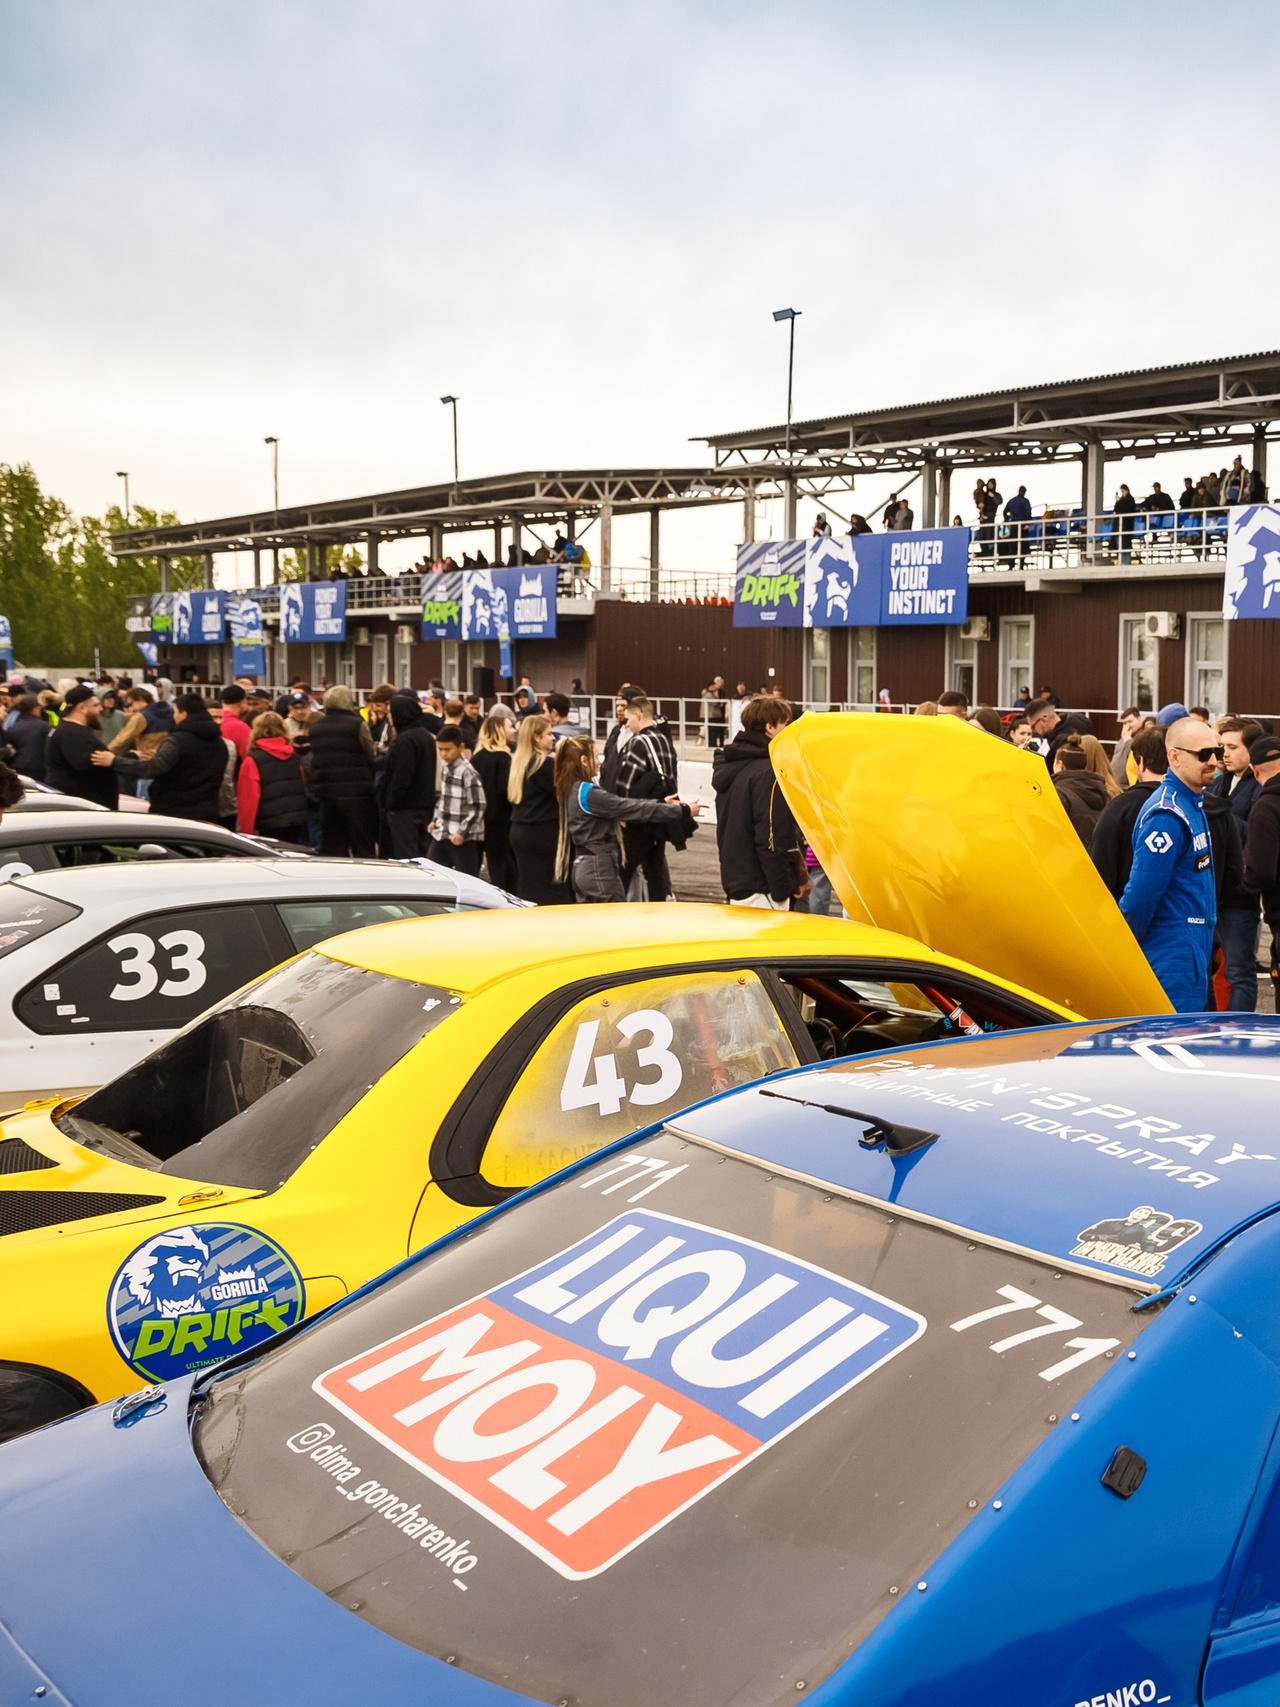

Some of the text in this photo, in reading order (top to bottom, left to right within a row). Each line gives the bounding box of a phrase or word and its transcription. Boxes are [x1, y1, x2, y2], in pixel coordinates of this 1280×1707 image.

[890, 540, 944, 567] POWER
[890, 566, 929, 590] YOUR
[888, 589, 956, 615] INSTINCT
[109, 929, 207, 1001] 33
[560, 1009, 684, 1116] 43
[579, 1154, 690, 1203] 771
[1000, 1112, 1221, 1189] ПОКРЫТИЯ
[211, 1277, 268, 1301] GORILLA
[513, 1224, 891, 1420] LIQUI
[949, 1284, 1121, 1381] 771
[185, 1356, 224, 1370] ULTIMATE
[346, 1313, 741, 1536] MOLY
